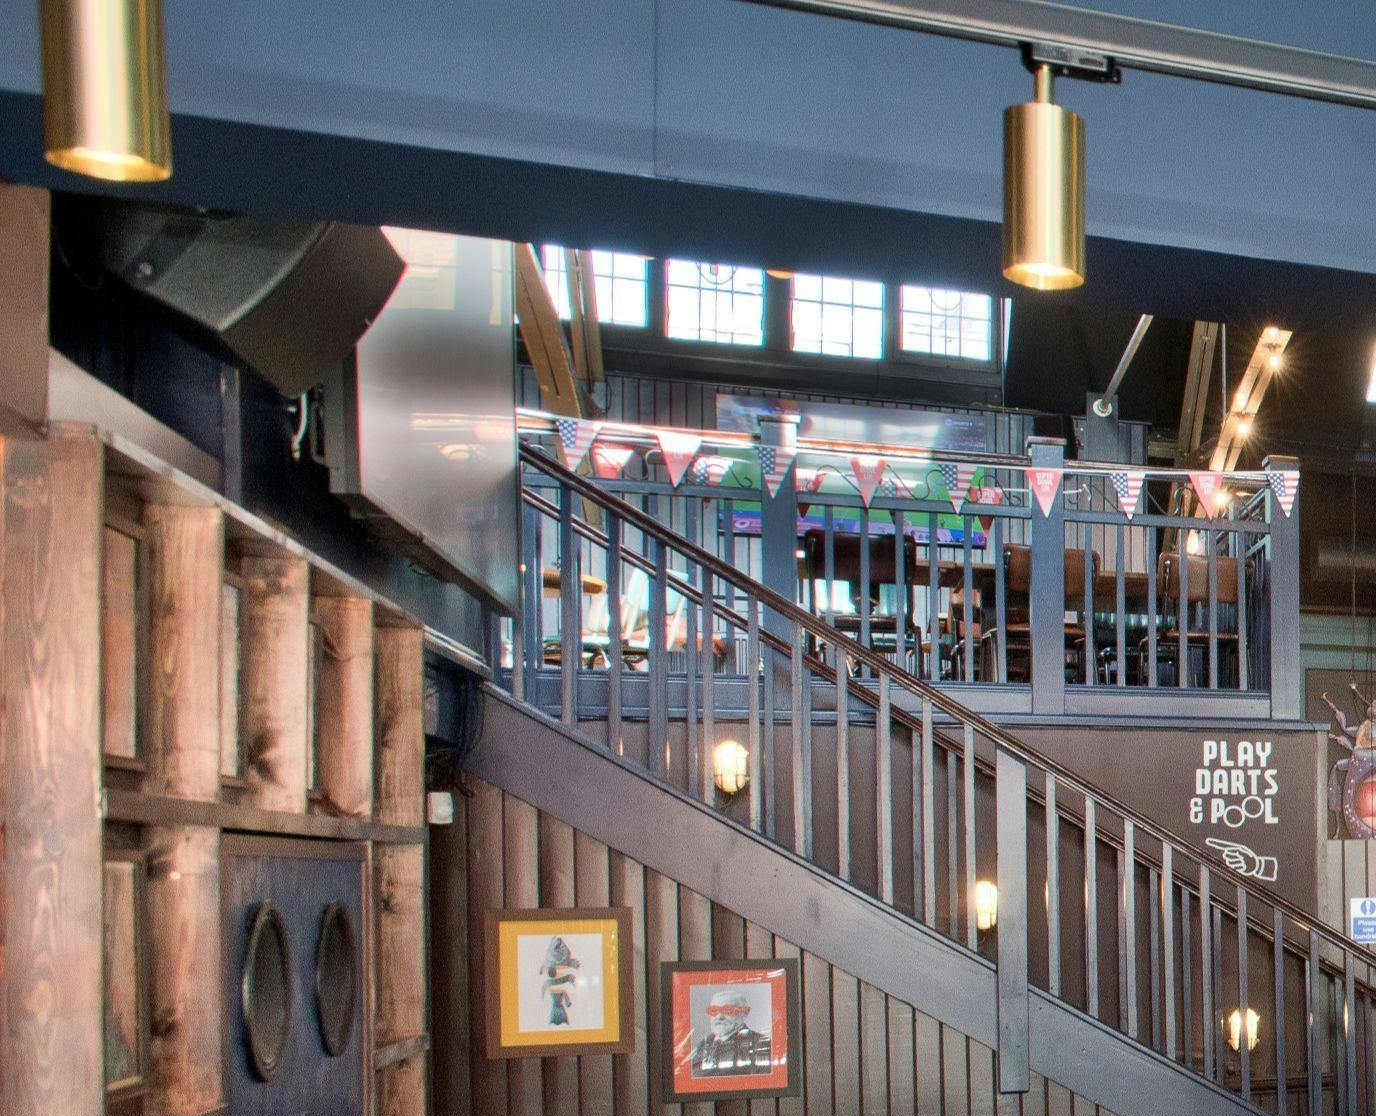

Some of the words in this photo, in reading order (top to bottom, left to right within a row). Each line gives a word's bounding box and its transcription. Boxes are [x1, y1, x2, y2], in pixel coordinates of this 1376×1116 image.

[1203, 740, 1272, 767] PLAY
[1195, 768, 1279, 795] DARTS
[1189, 797, 1204, 824] &
[1210, 796, 1279, 828] POOL
